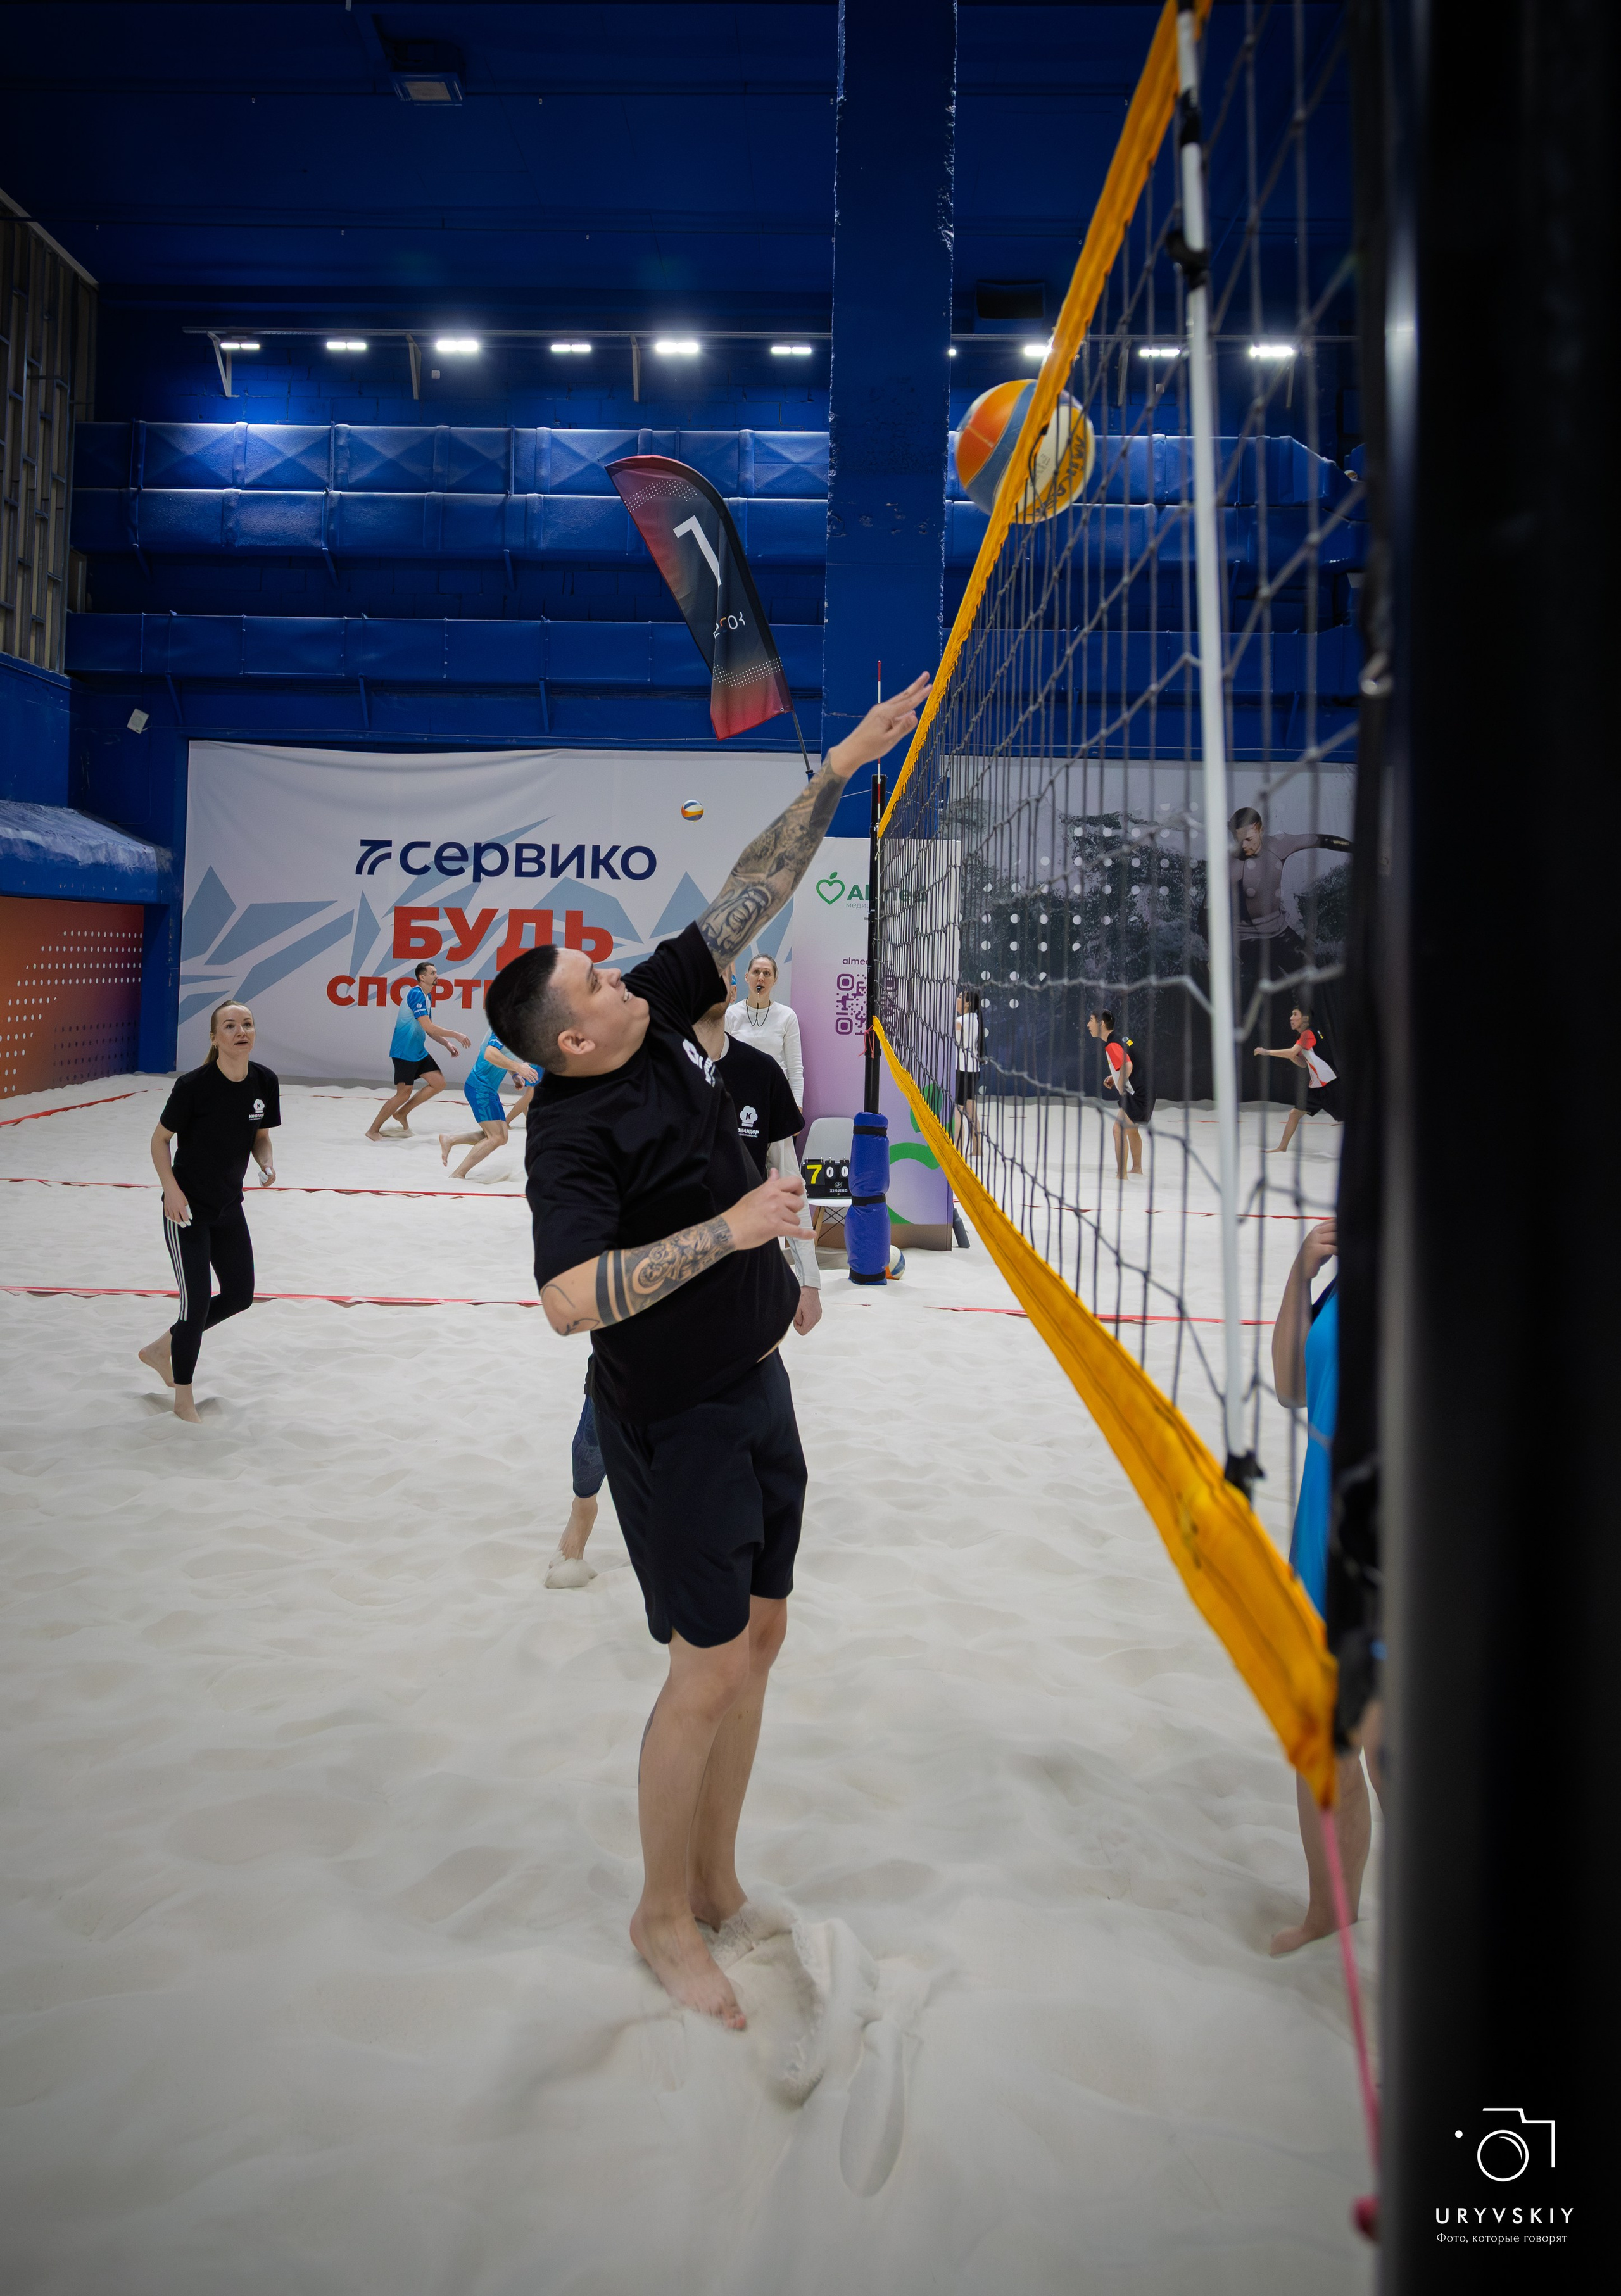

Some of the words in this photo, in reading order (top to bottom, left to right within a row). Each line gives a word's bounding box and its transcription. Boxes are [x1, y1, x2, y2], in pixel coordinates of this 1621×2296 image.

[392, 905, 614, 971] БУДЬ
[807, 1164, 823, 1185] 7
[826, 1166, 834, 1178] 0
[841, 1166, 849, 1177] 0
